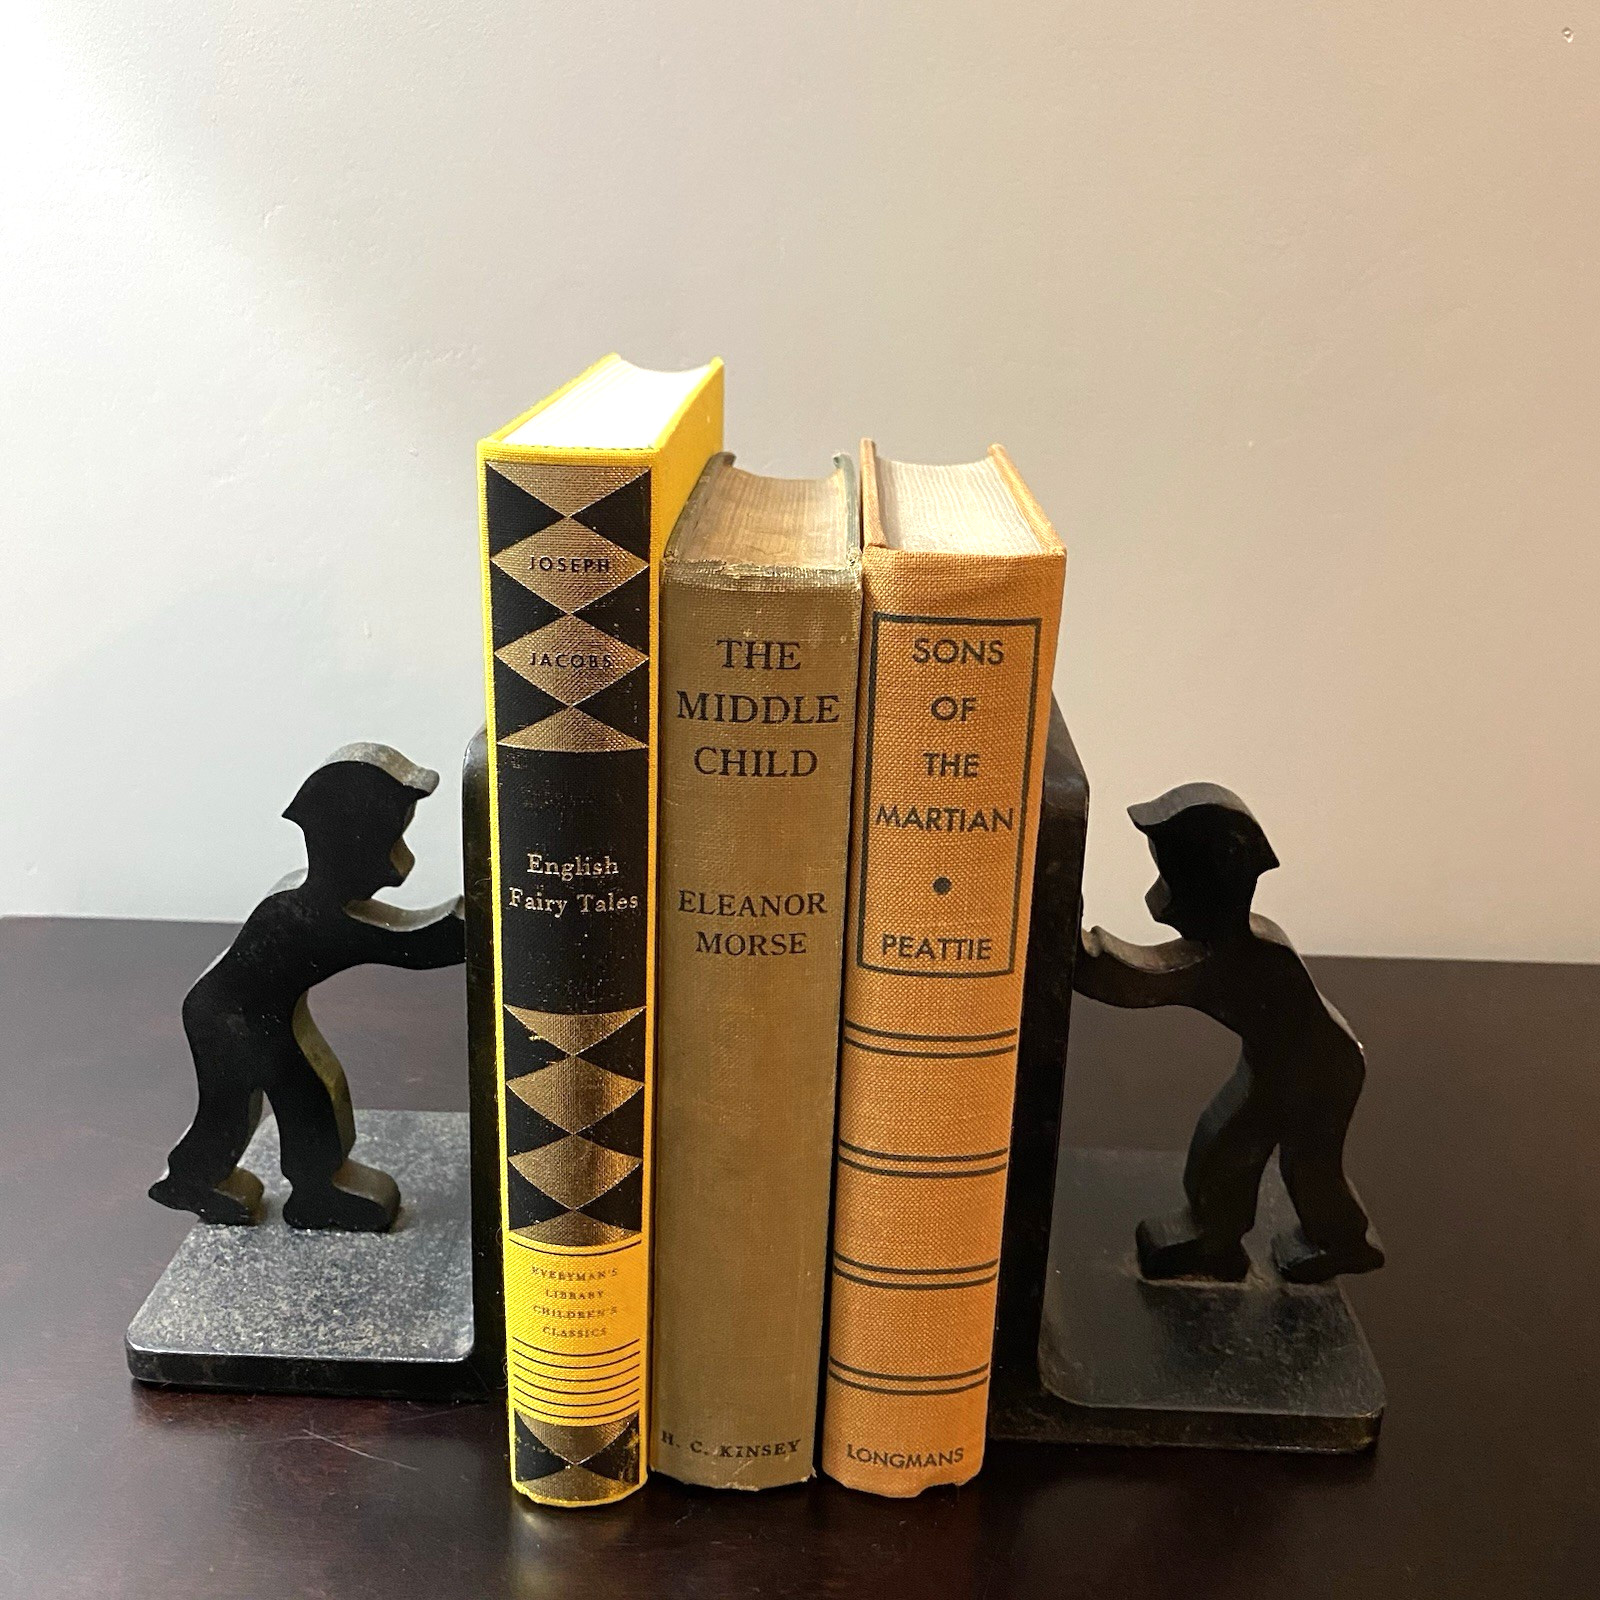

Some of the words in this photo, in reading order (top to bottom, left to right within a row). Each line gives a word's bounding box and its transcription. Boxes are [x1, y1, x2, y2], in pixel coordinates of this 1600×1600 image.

[529, 555, 610, 573] JOSEPH
[530, 652, 613, 669] JACOBS
[716, 638, 801, 670] THE
[912, 638, 1005, 666] SONS
[676, 690, 840, 724] MIDDLE
[931, 696, 977, 722] OF
[694, 746, 818, 777] CHILD
[923, 752, 980, 778] THE
[875, 805, 1014, 833] MARTIAN
[527, 853, 619, 881] English
[508, 886, 567, 918] Fairy
[576, 892, 639, 913] Tales
[678, 890, 828, 917] ELEANOR
[696, 931, 807, 956] MORSE
[881, 933, 992, 961] PEATTIE
[532, 1266, 618, 1281] EVERYMAN'S
[546, 1289, 604, 1300] LIBRARY
[533, 1305, 618, 1319] CHILDREN'S
[542, 1326, 607, 1338] CLASSICS
[661, 1430, 681, 1448] H.
[690, 1441, 708, 1455] C.
[719, 1439, 801, 1458] KINSEY
[847, 1443, 964, 1469] LONGMANS
